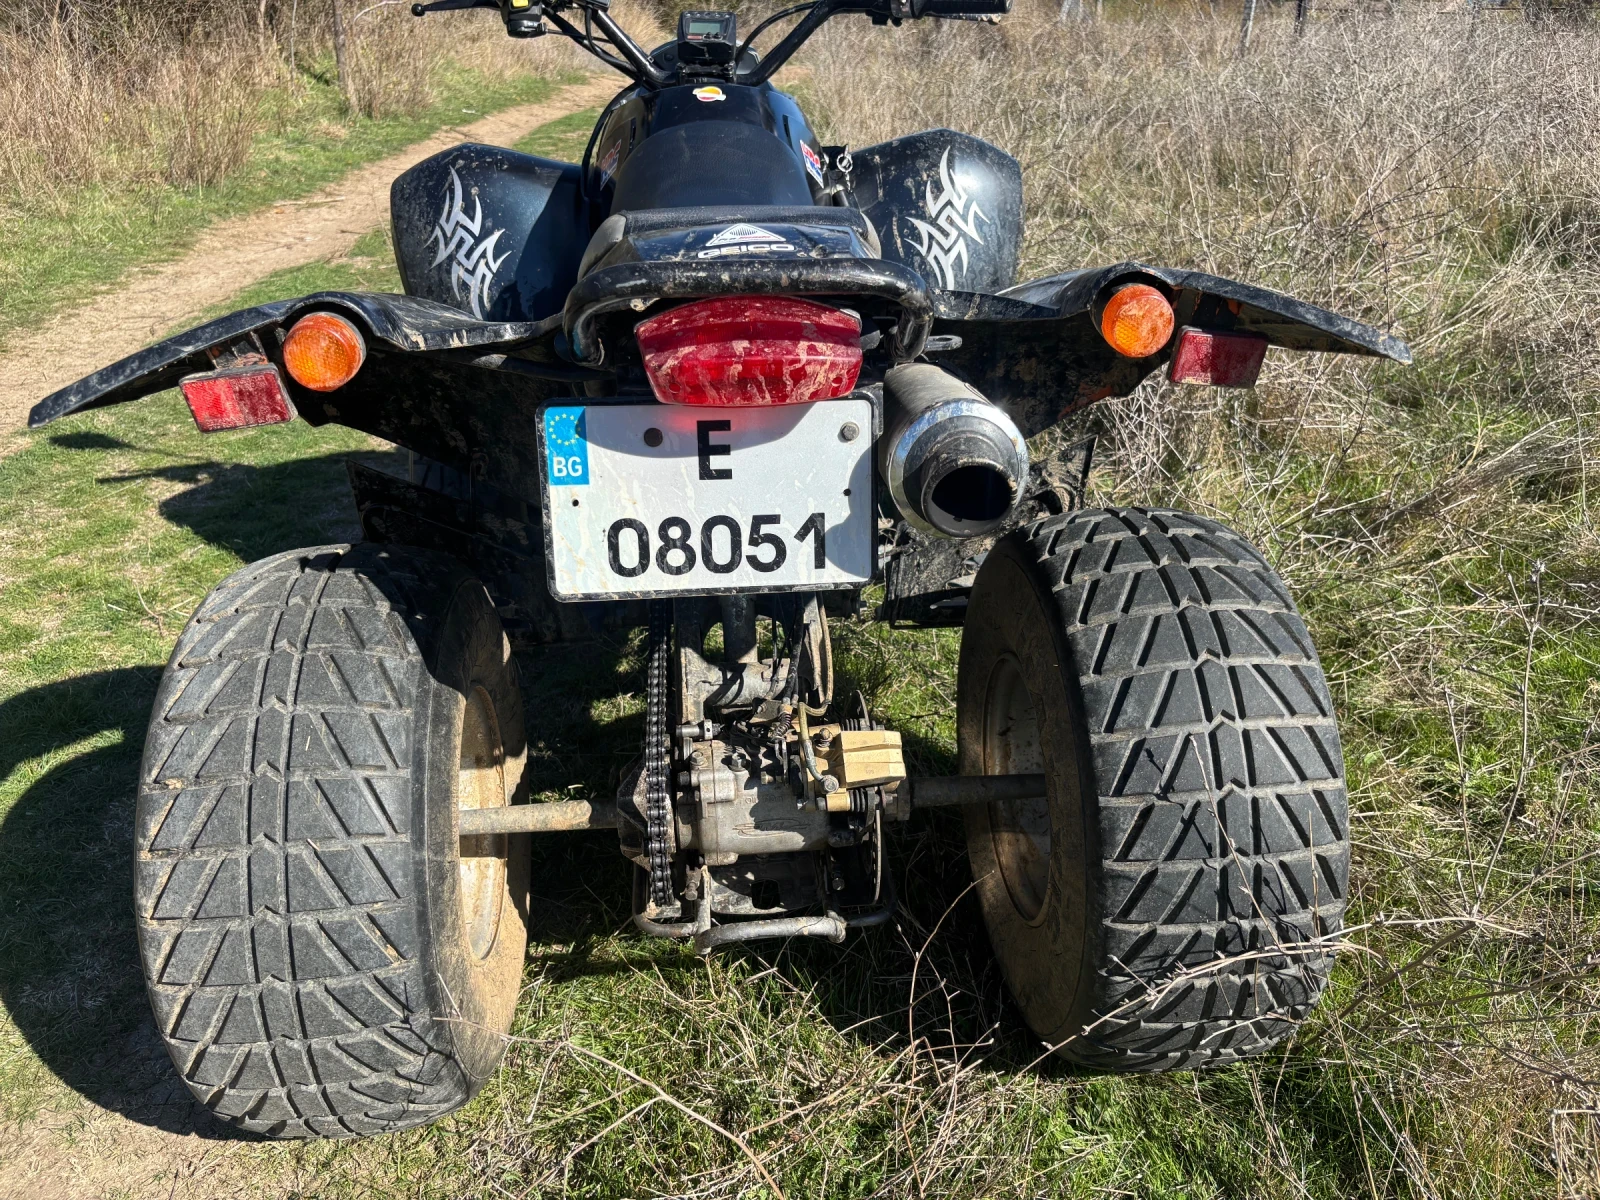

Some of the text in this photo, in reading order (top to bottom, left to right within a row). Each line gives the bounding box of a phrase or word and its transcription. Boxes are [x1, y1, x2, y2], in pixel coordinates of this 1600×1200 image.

[697, 243, 795, 259] GEICO
[552, 456, 583, 477] BG
[696, 419, 733, 480] E
[606, 512, 826, 578] 08051
